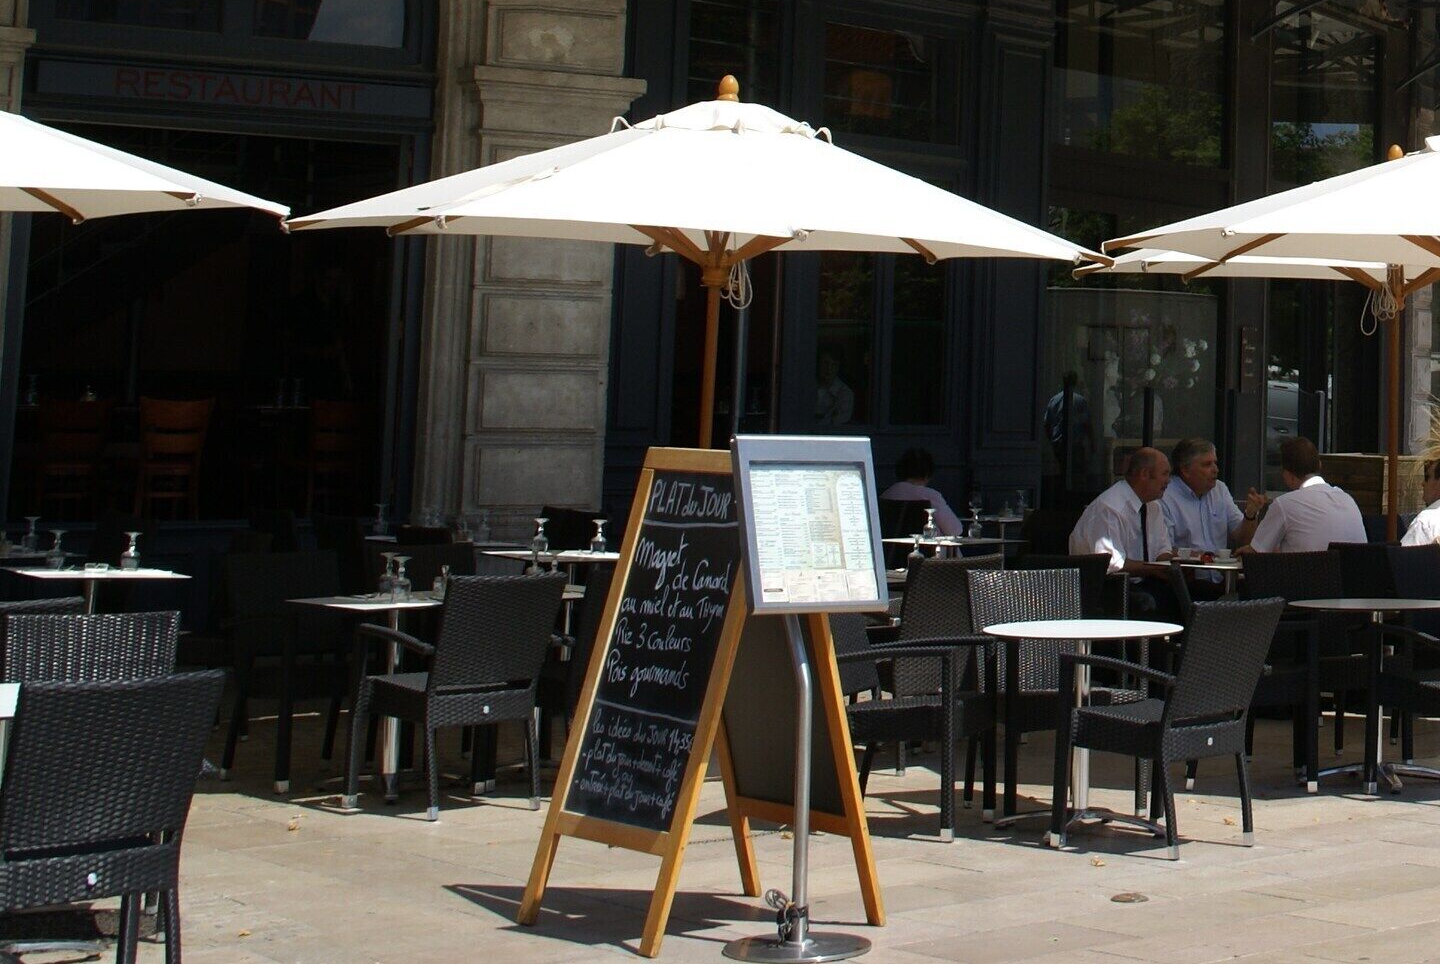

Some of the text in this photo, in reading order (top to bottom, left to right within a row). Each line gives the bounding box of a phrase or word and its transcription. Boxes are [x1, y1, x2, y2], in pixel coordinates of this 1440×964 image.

[113, 67, 367, 110] RESTAURANT
[649, 479, 691, 515] PLAT
[697, 485, 732, 519] JOUR
[672, 559, 688, 591] de
[621, 596, 636, 614] au
[640, 584, 669, 616] miel
[667, 592, 681, 617] et
[680, 603, 694, 620] au
[636, 622, 648, 648] 3
[606, 648, 690, 698] Pois gourmands
[633, 722, 647, 744] du
